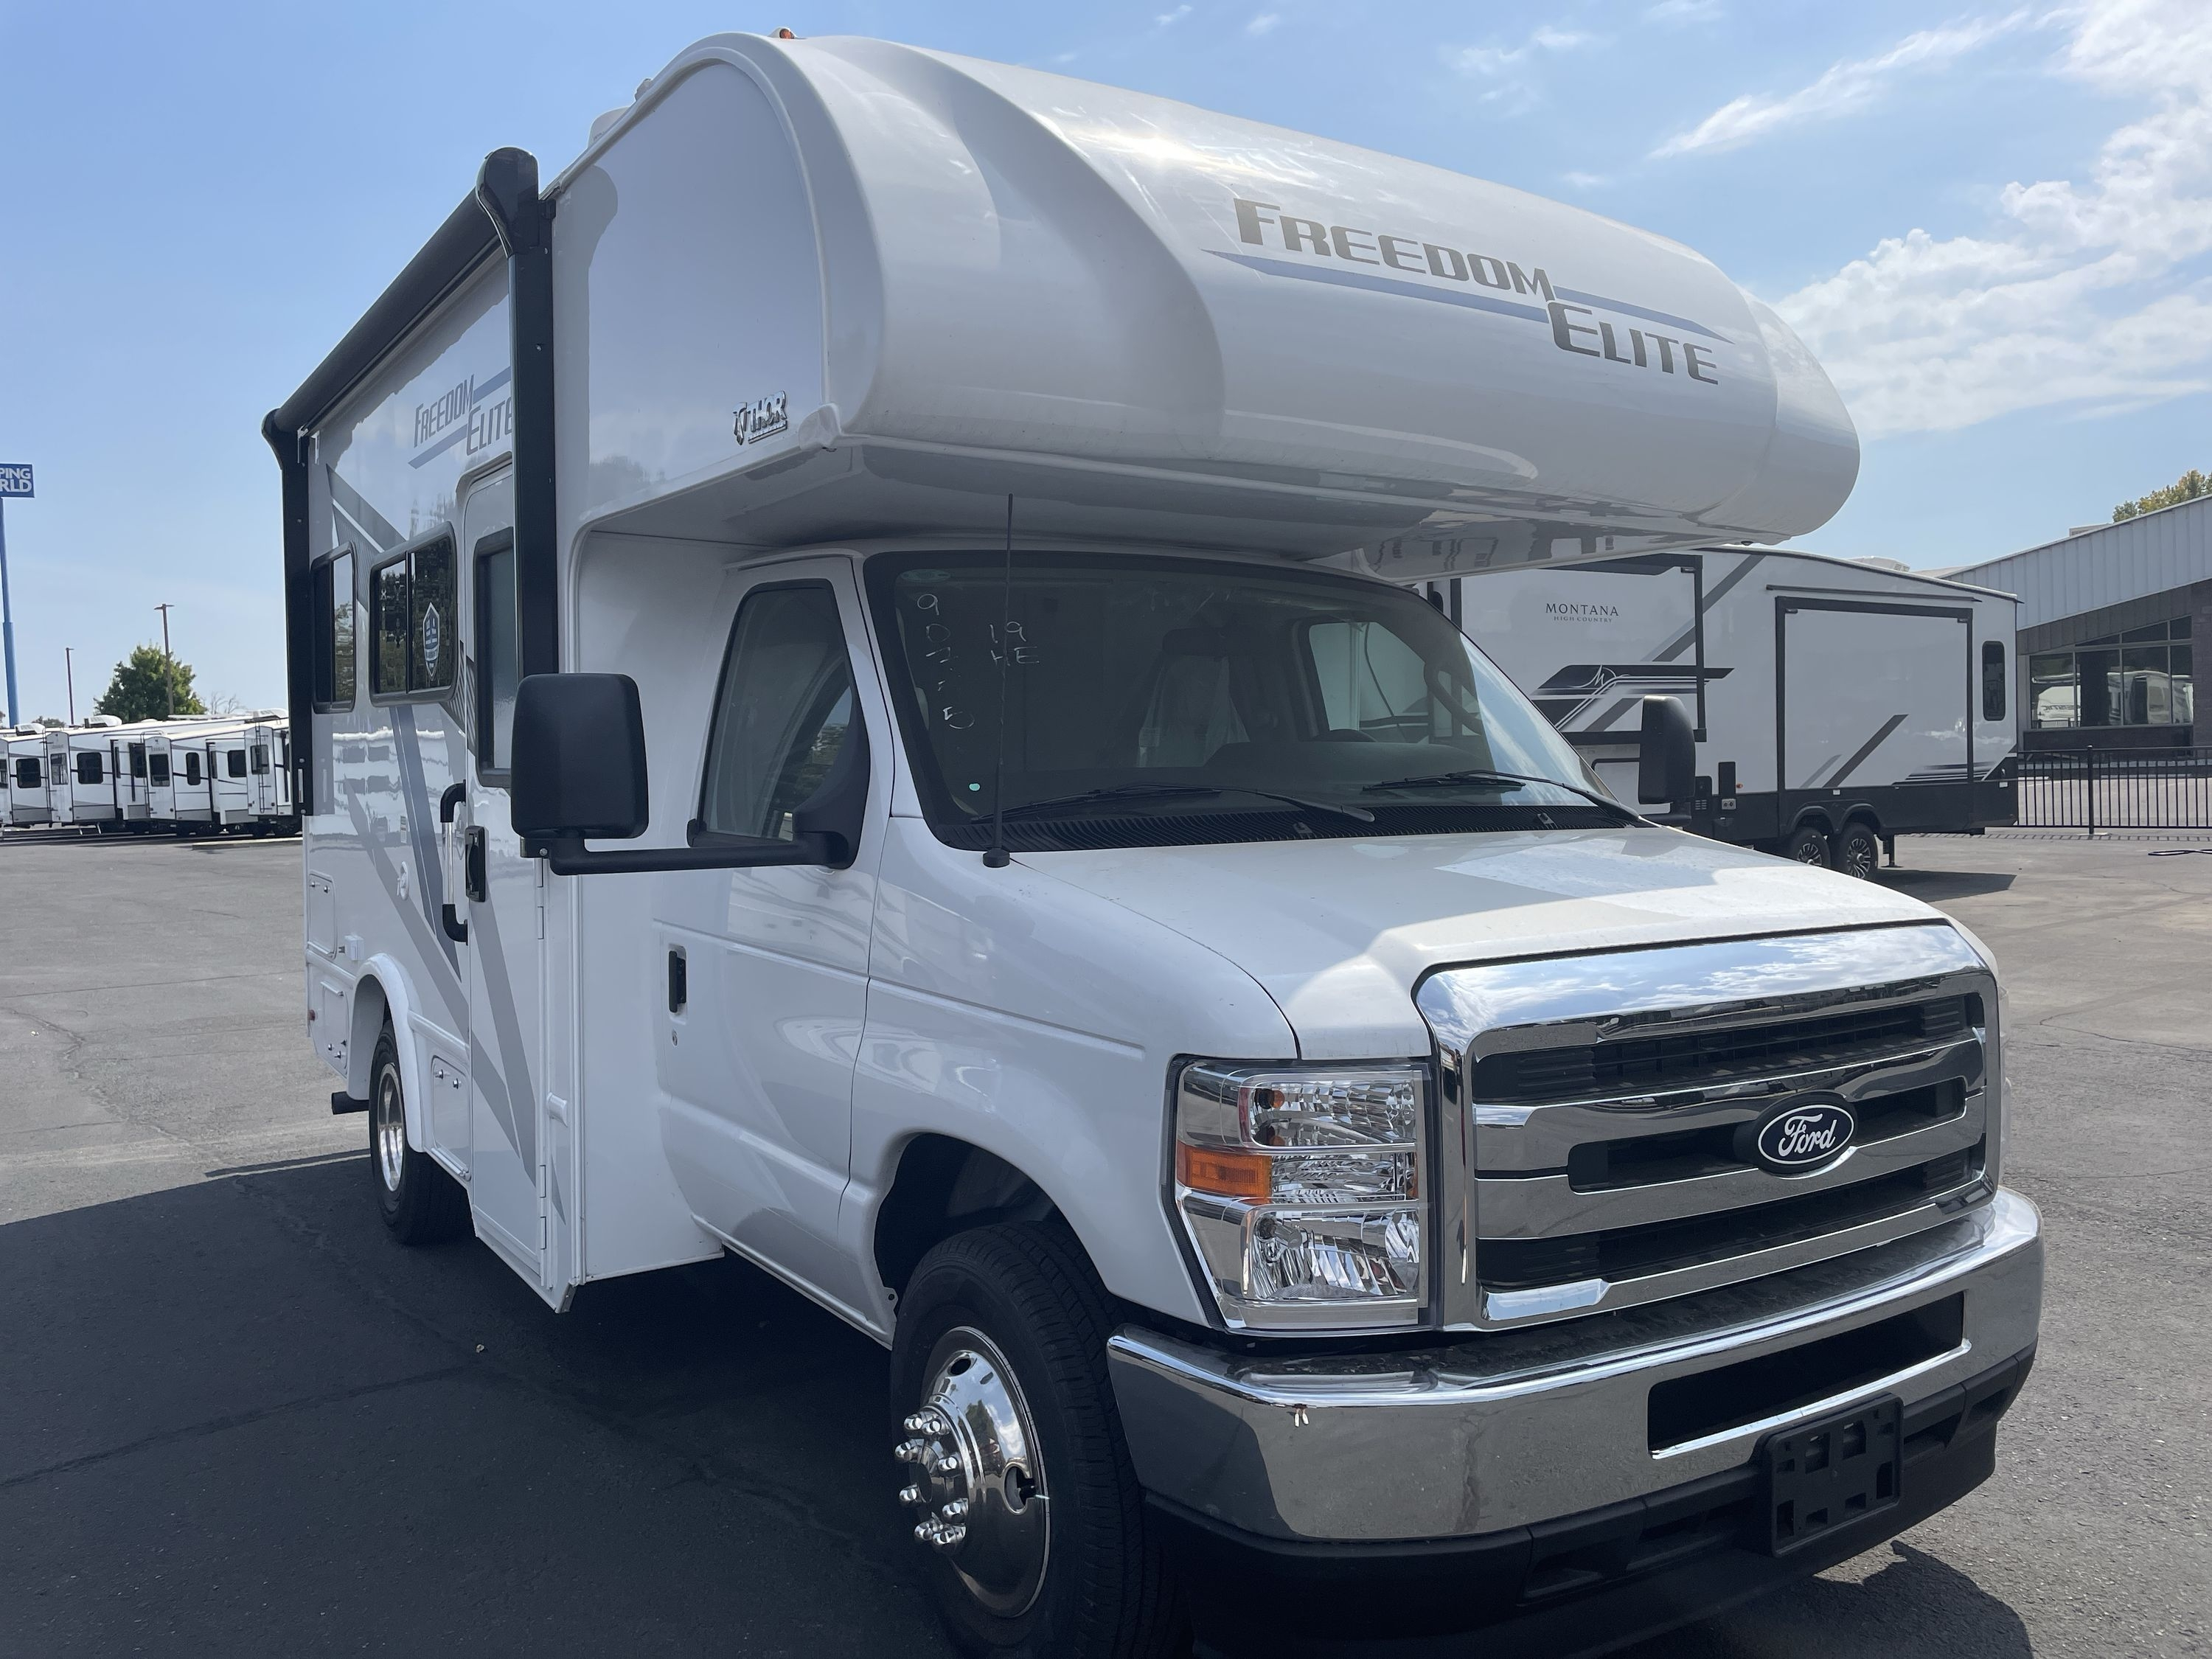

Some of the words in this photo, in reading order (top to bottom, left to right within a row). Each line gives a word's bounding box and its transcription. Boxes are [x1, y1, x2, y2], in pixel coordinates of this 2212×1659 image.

[1234, 198, 1557, 302] FREEDOM
[1548, 301, 1719, 386] ELITE
[414, 373, 475, 449] FREEDOM
[466, 396, 512, 456] ELITE
[746, 390, 787, 433] THOR
[1545, 602, 1619, 616] MONTANA
[1778, 1113, 1837, 1157] Ford
